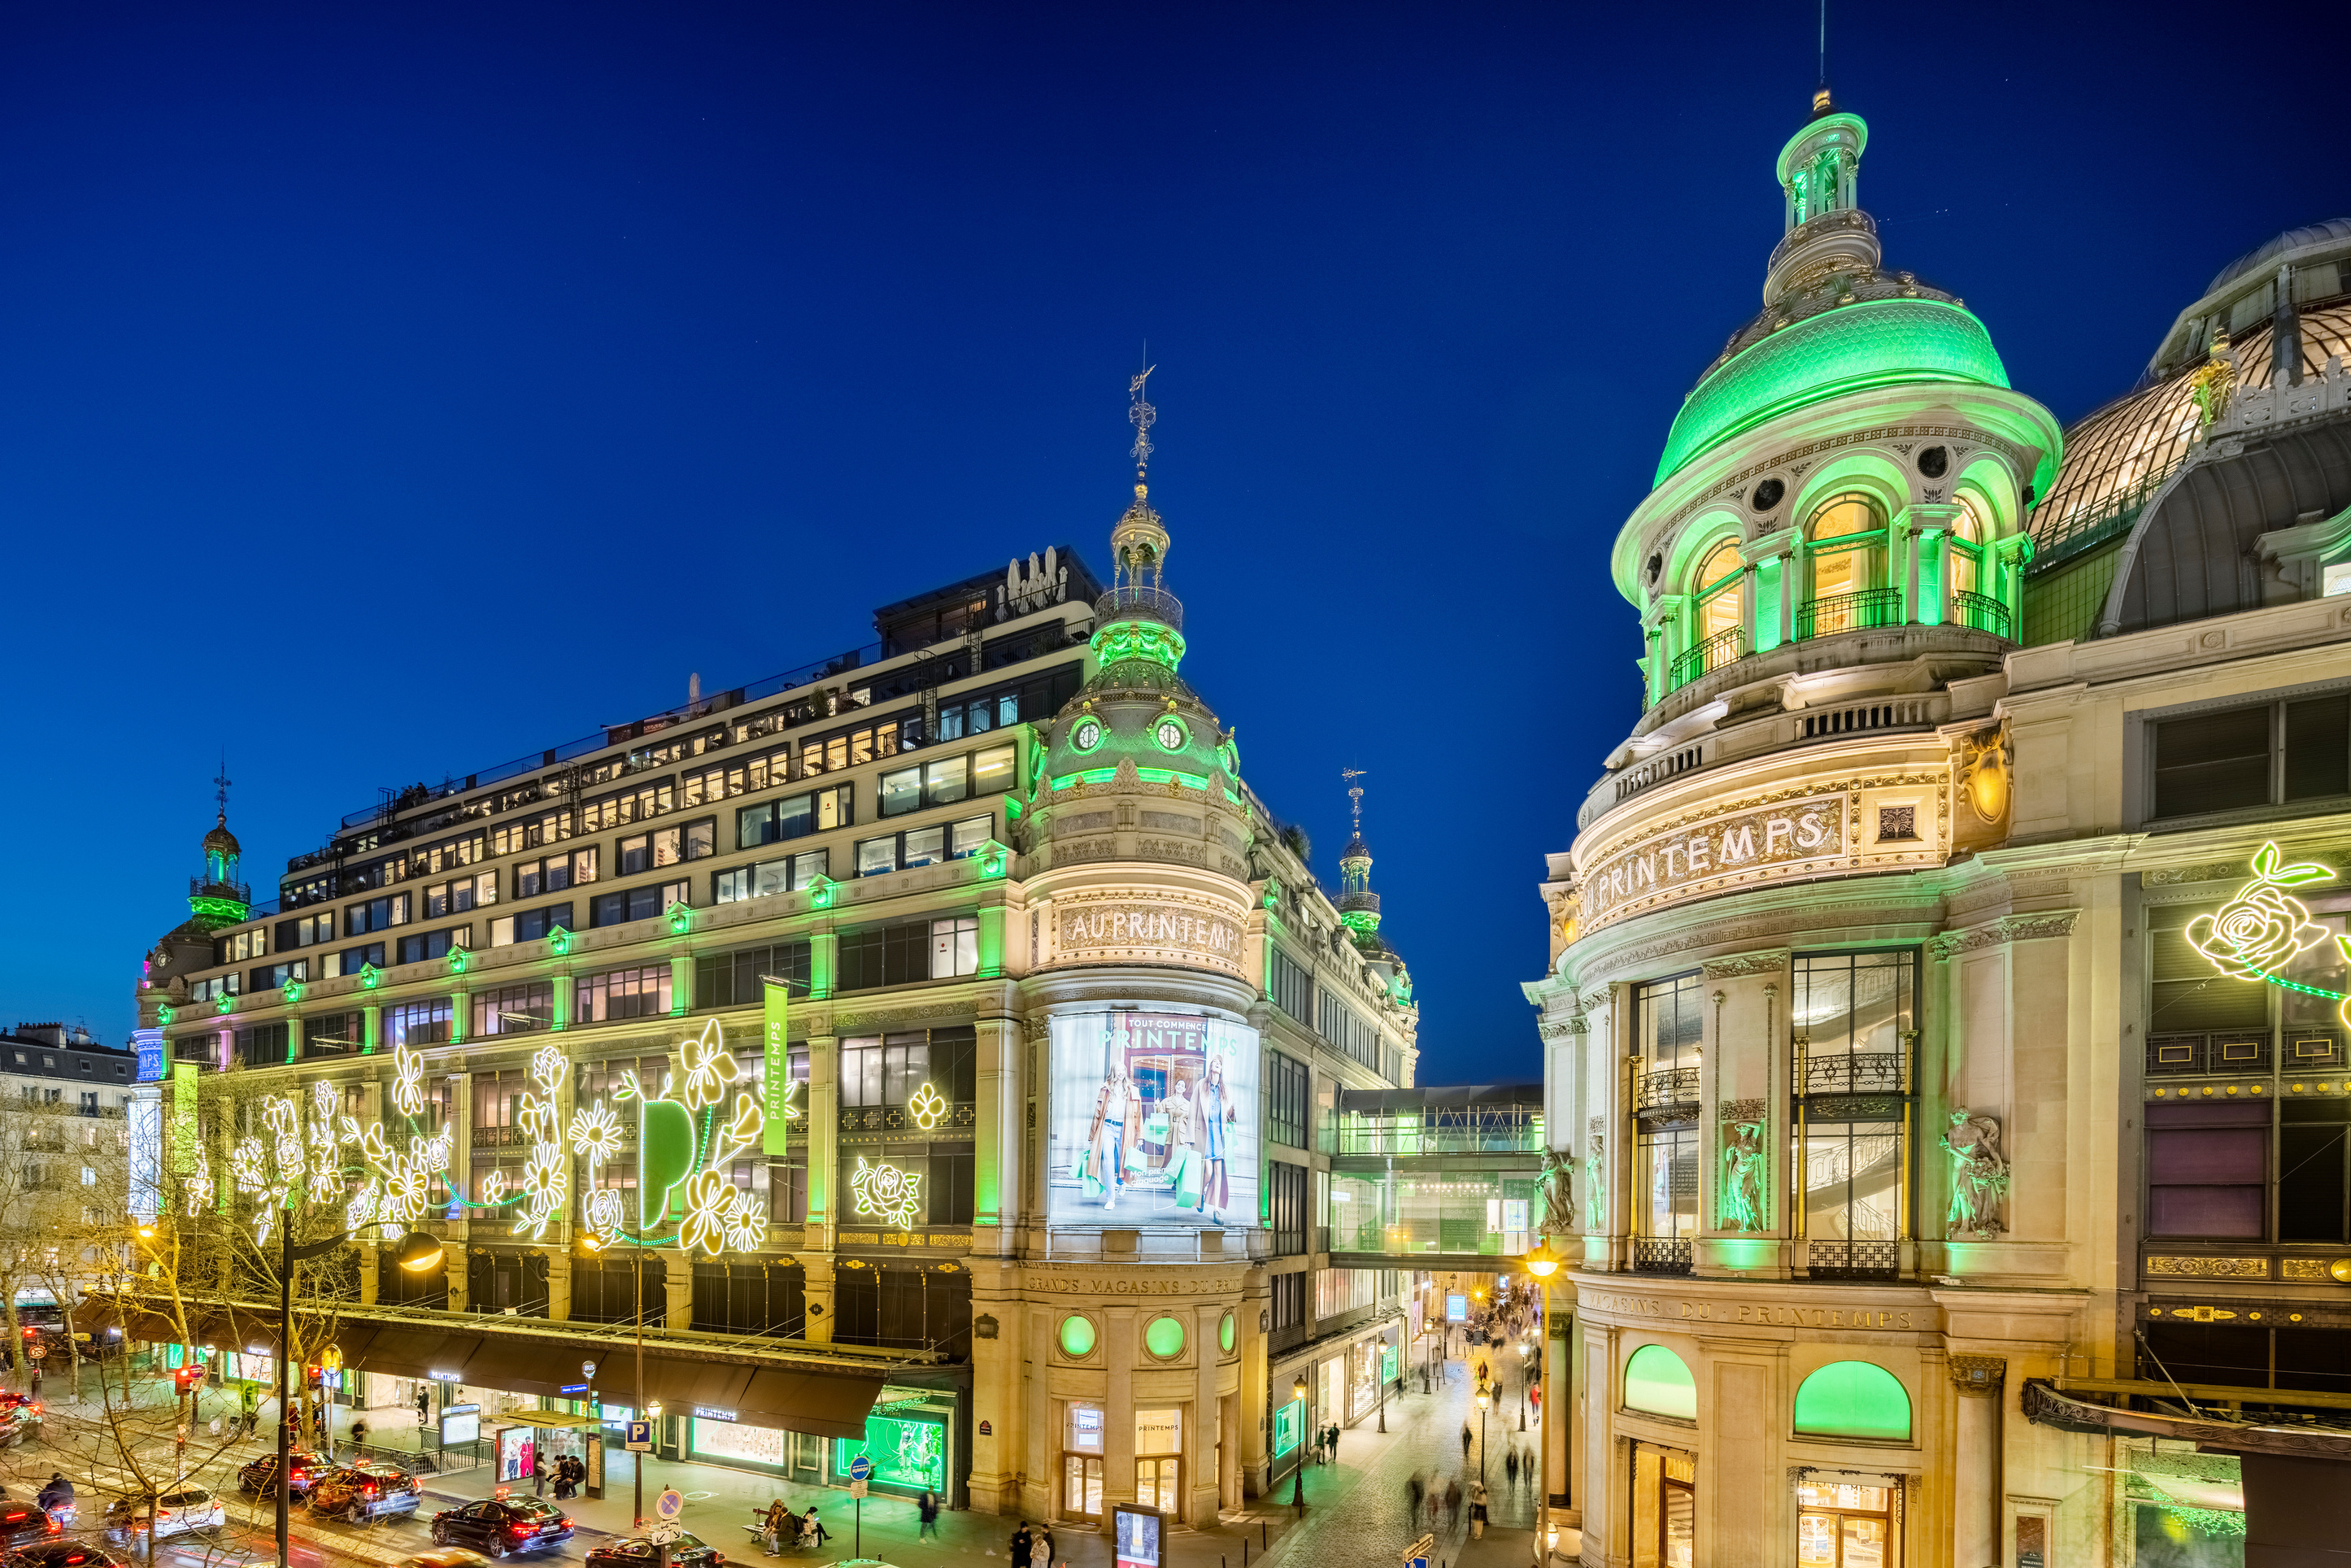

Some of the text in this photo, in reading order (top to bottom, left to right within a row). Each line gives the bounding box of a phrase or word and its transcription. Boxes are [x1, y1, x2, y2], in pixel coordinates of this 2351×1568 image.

[1599, 812, 1822, 905] PRINTEMPS
[1072, 912, 1239, 956] AU PRINTEMPS
[1129, 1019, 1154, 1027] TOUT
[1156, 1020, 1207, 1031] COMMENCE
[1098, 1030, 1238, 1056] PRINTEMPS
[769, 1021, 781, 1120] PRINTEMPS
[1130, 1165, 1178, 1178] Mon premier
[1130, 1175, 1169, 1187] craquage
[1029, 1277, 1079, 1291] GRANDS
[1091, 1280, 1179, 1294] MAGASINS
[1191, 1280, 1208, 1292] DU
[1590, 1293, 1659, 1315] MAGASINS
[1682, 1302, 1711, 1319] DU
[1738, 1305, 1912, 1330] PRINTEMPS
[431, 1371, 461, 1383] PRINTEMPS
[695, 1407, 737, 1421] PRINTEMPS
[632, 1424, 645, 1441] P
[1066, 1422, 1104, 1431] PRINTEMPS
